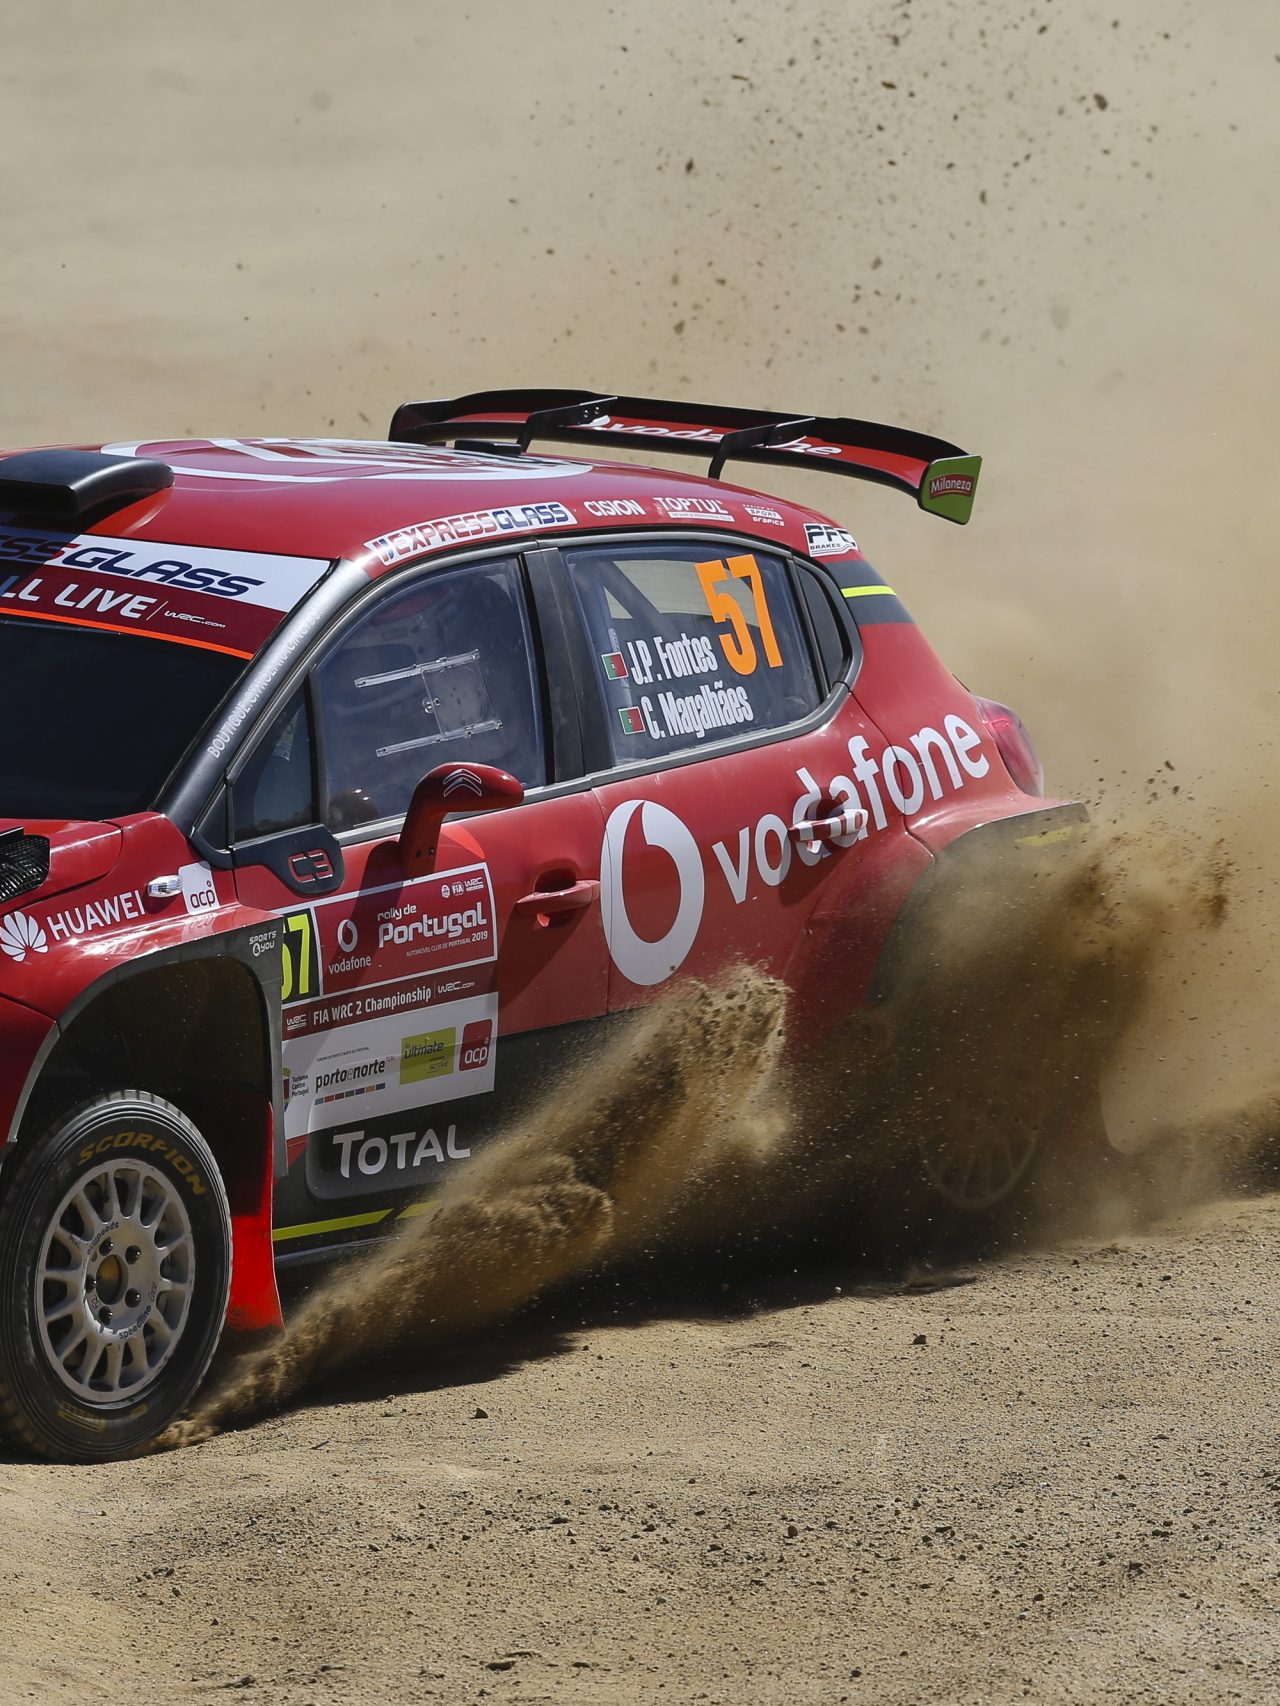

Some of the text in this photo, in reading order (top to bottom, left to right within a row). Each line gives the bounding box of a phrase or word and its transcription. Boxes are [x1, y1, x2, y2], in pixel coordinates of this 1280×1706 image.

[930, 476, 972, 495] Milaneza
[583, 499, 646, 517] CISION
[653, 497, 728, 514] TOPTUL
[390, 503, 569, 557] EXPRESSGLASS
[54, 583, 158, 619] LIVE
[695, 554, 783, 675] 57
[653, 633, 718, 680] Fontes
[641, 680, 754, 740] C. Magalhães
[712, 713, 990, 905] vodafone
[190, 888, 216, 909] acp
[47, 890, 147, 941] HUAWEI
[378, 904, 417, 921] rally de
[379, 902, 488, 948] Portugal
[249, 930, 277, 946] SPORTS
[471, 931, 488, 942] 2019
[328, 956, 372, 975] vodafone
[287, 1014, 307, 1026] WRC
[313, 1010, 329, 1026] FIA
[332, 1005, 353, 1022] WRC
[355, 1001, 362, 1015] 2
[365, 986, 432, 1013] Championship
[404, 1040, 444, 1059] ultimate
[464, 1047, 488, 1064] acp
[292, 1082, 305, 1090] Centro
[315, 1059, 385, 1093] portoenorte
[291, 1088, 309, 1098] Portugal
[79, 1131, 206, 1196] SCORPION
[332, 1124, 470, 1179] TOTAL
